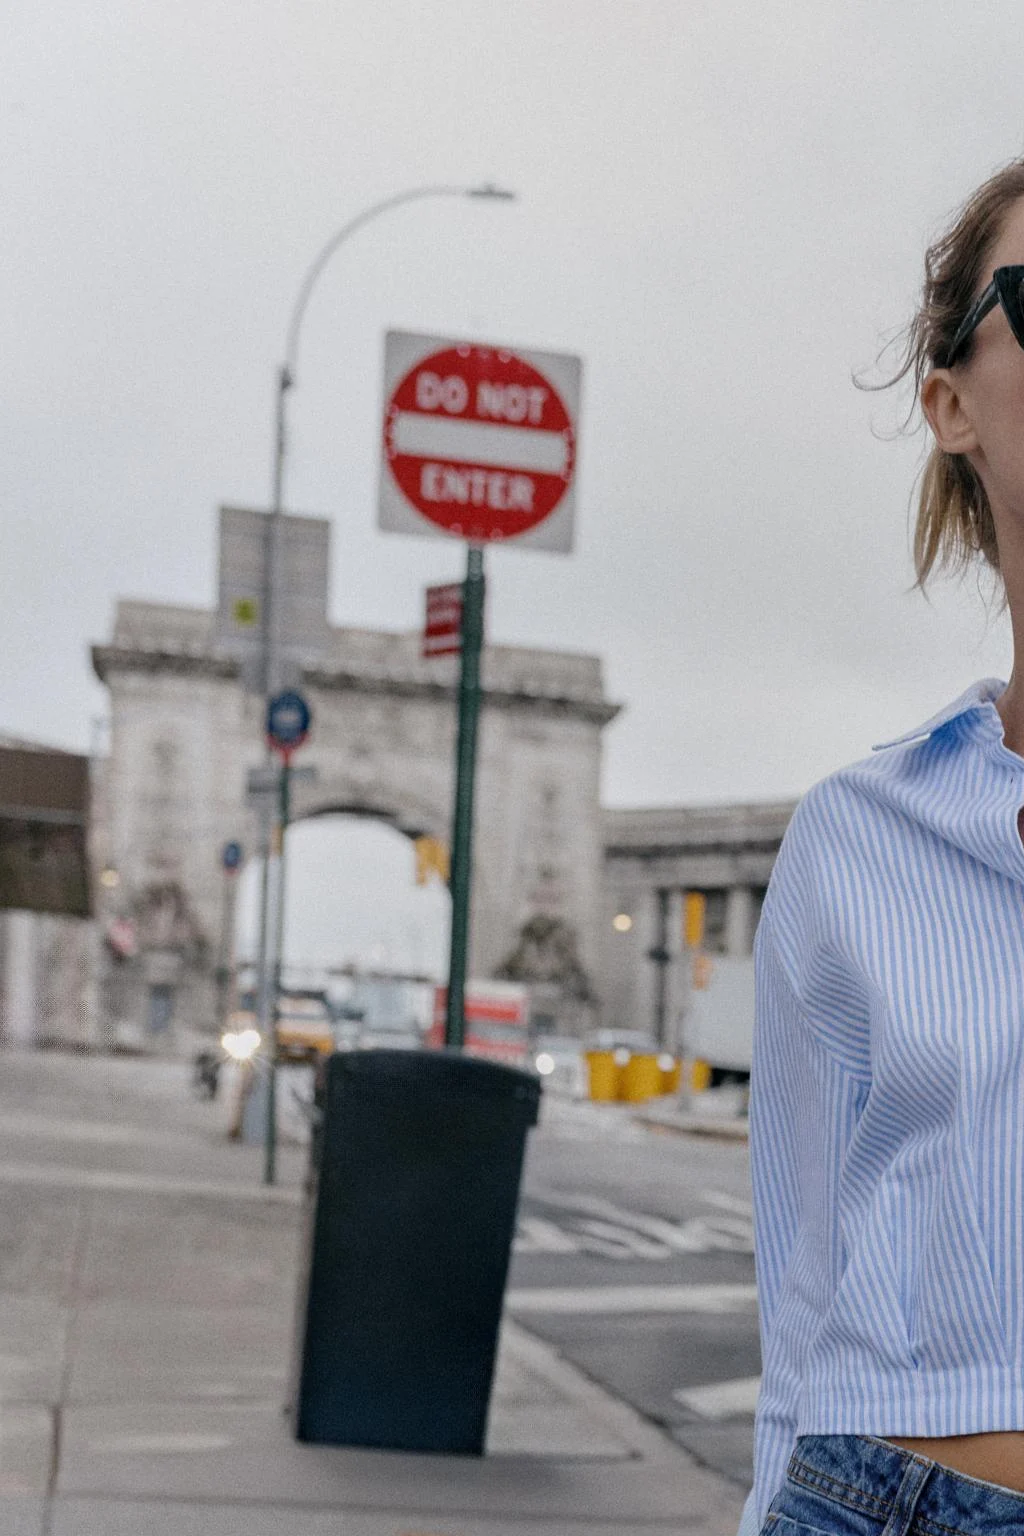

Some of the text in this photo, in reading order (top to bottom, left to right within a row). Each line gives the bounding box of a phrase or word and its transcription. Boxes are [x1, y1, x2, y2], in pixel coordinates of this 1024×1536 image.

[416, 371, 546, 424] DO NOT
[420, 463, 533, 512] ENTER
